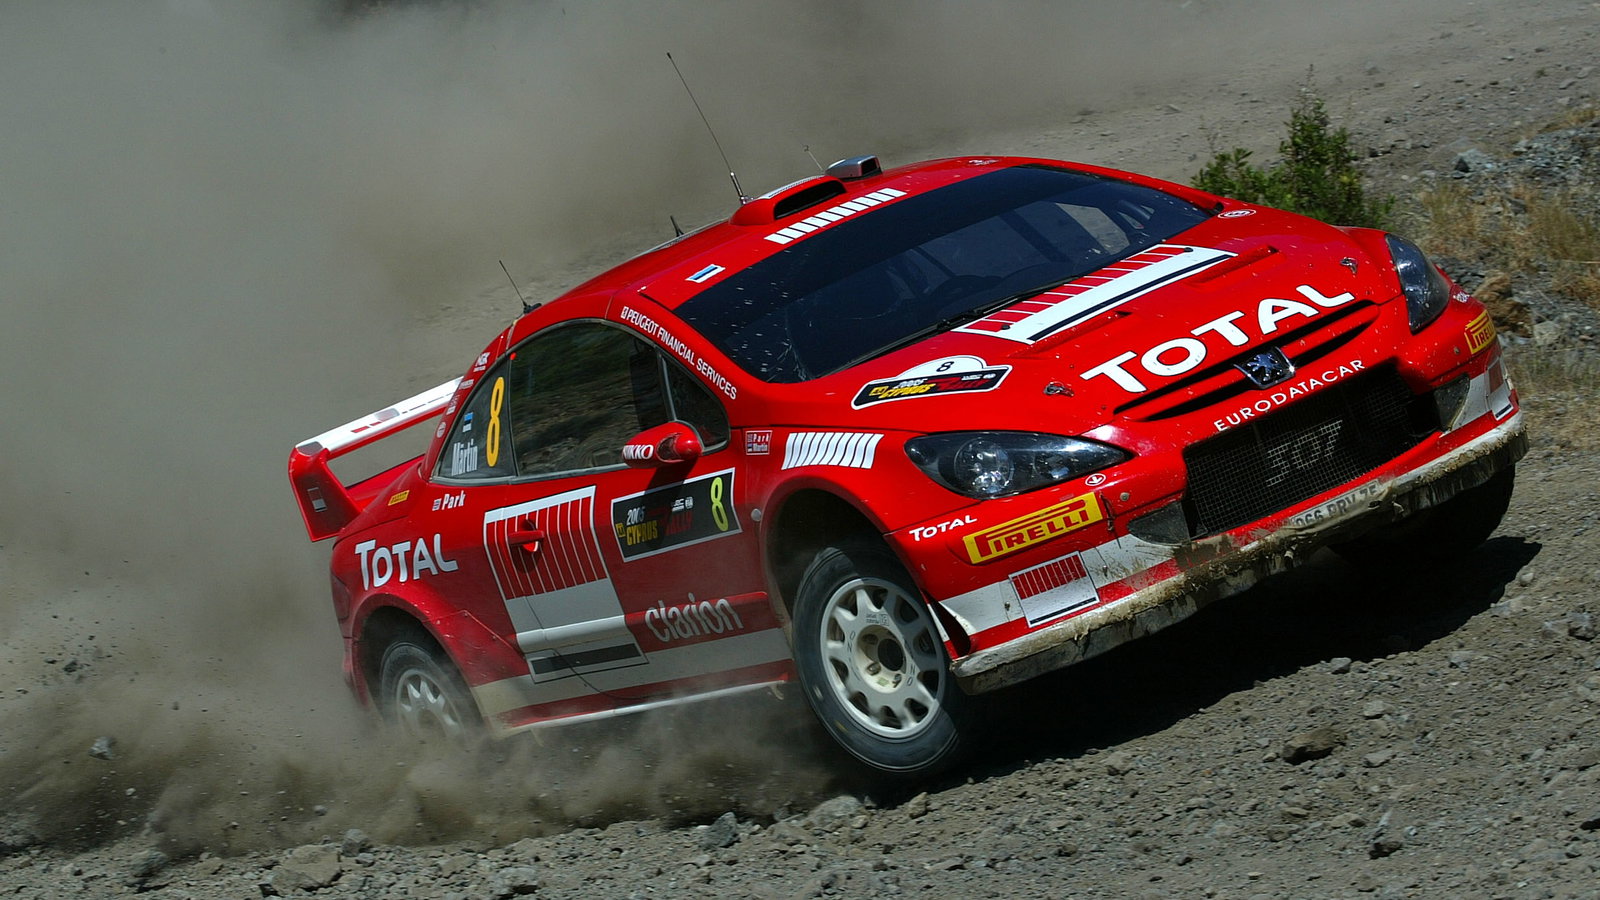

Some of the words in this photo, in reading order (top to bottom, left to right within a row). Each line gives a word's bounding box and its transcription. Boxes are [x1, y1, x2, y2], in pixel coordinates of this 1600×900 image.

[626, 308, 660, 336] PEUGEOT
[657, 326, 695, 366] FINANCIAL
[696, 358, 738, 400] SERVICES
[1080, 284, 1355, 393] TOTAL
[936, 361, 955, 373] 8
[486, 376, 505, 467] 8
[1213, 359, 1366, 432] EURODATACAR
[622, 444, 654, 460] NIKKO
[1266, 419, 1343, 487] 307
[442, 490, 466, 511] Park
[710, 477, 729, 532] 8
[908, 515, 977, 542] TOTAL
[974, 499, 1090, 557] PIRELLI
[626, 520, 658, 546] CYPRUS
[355, 533, 459, 591] TOTAL
[645, 592, 744, 642] clarion
